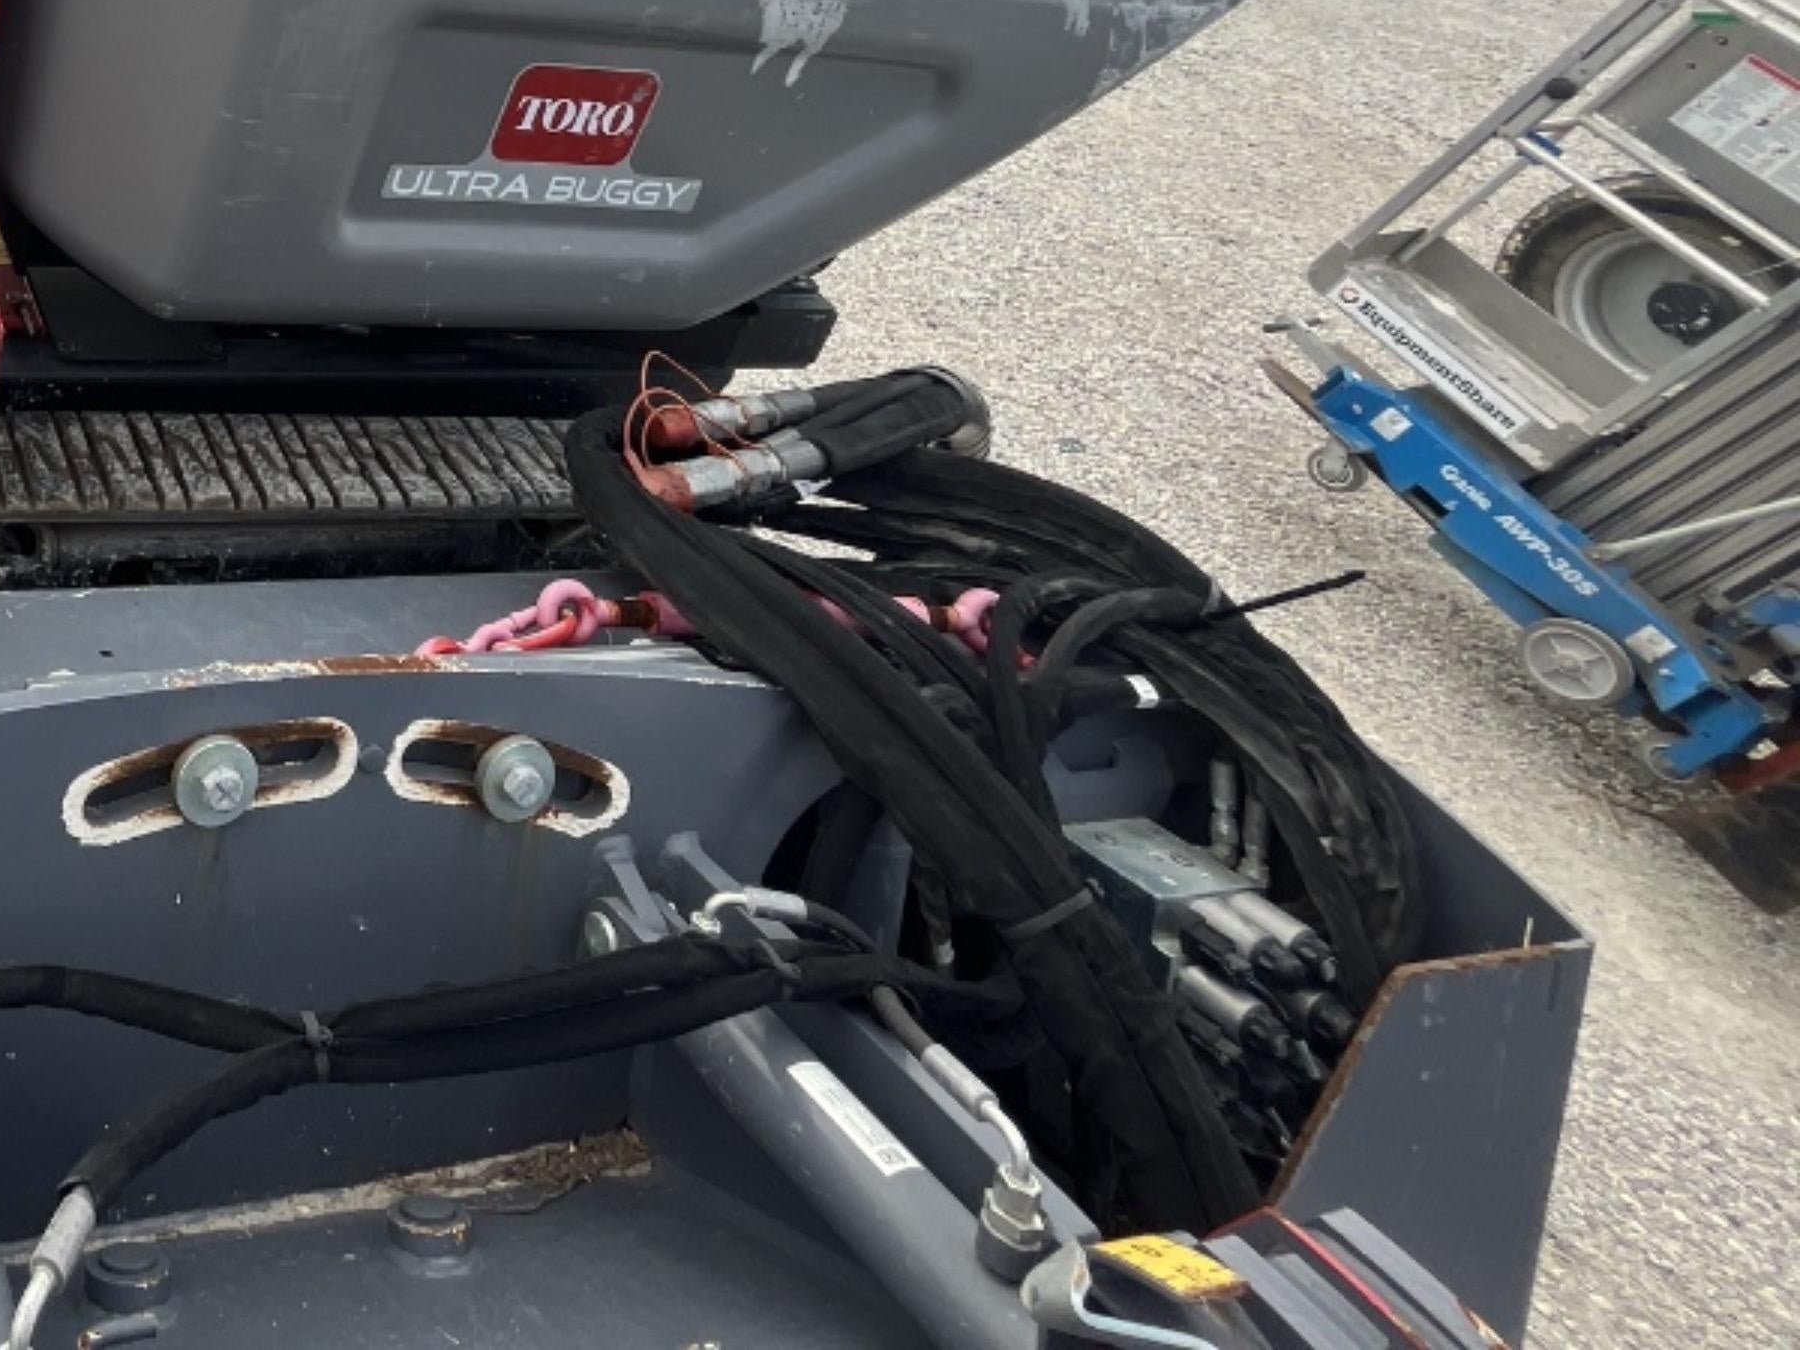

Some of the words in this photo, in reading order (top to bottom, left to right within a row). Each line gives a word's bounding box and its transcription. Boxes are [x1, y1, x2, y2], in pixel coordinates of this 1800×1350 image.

[515, 95, 636, 137] TORO
[390, 167, 530, 200] ULTRA
[545, 175, 691, 209] BUGGY
[1493, 514, 1600, 597] AWP-30S
